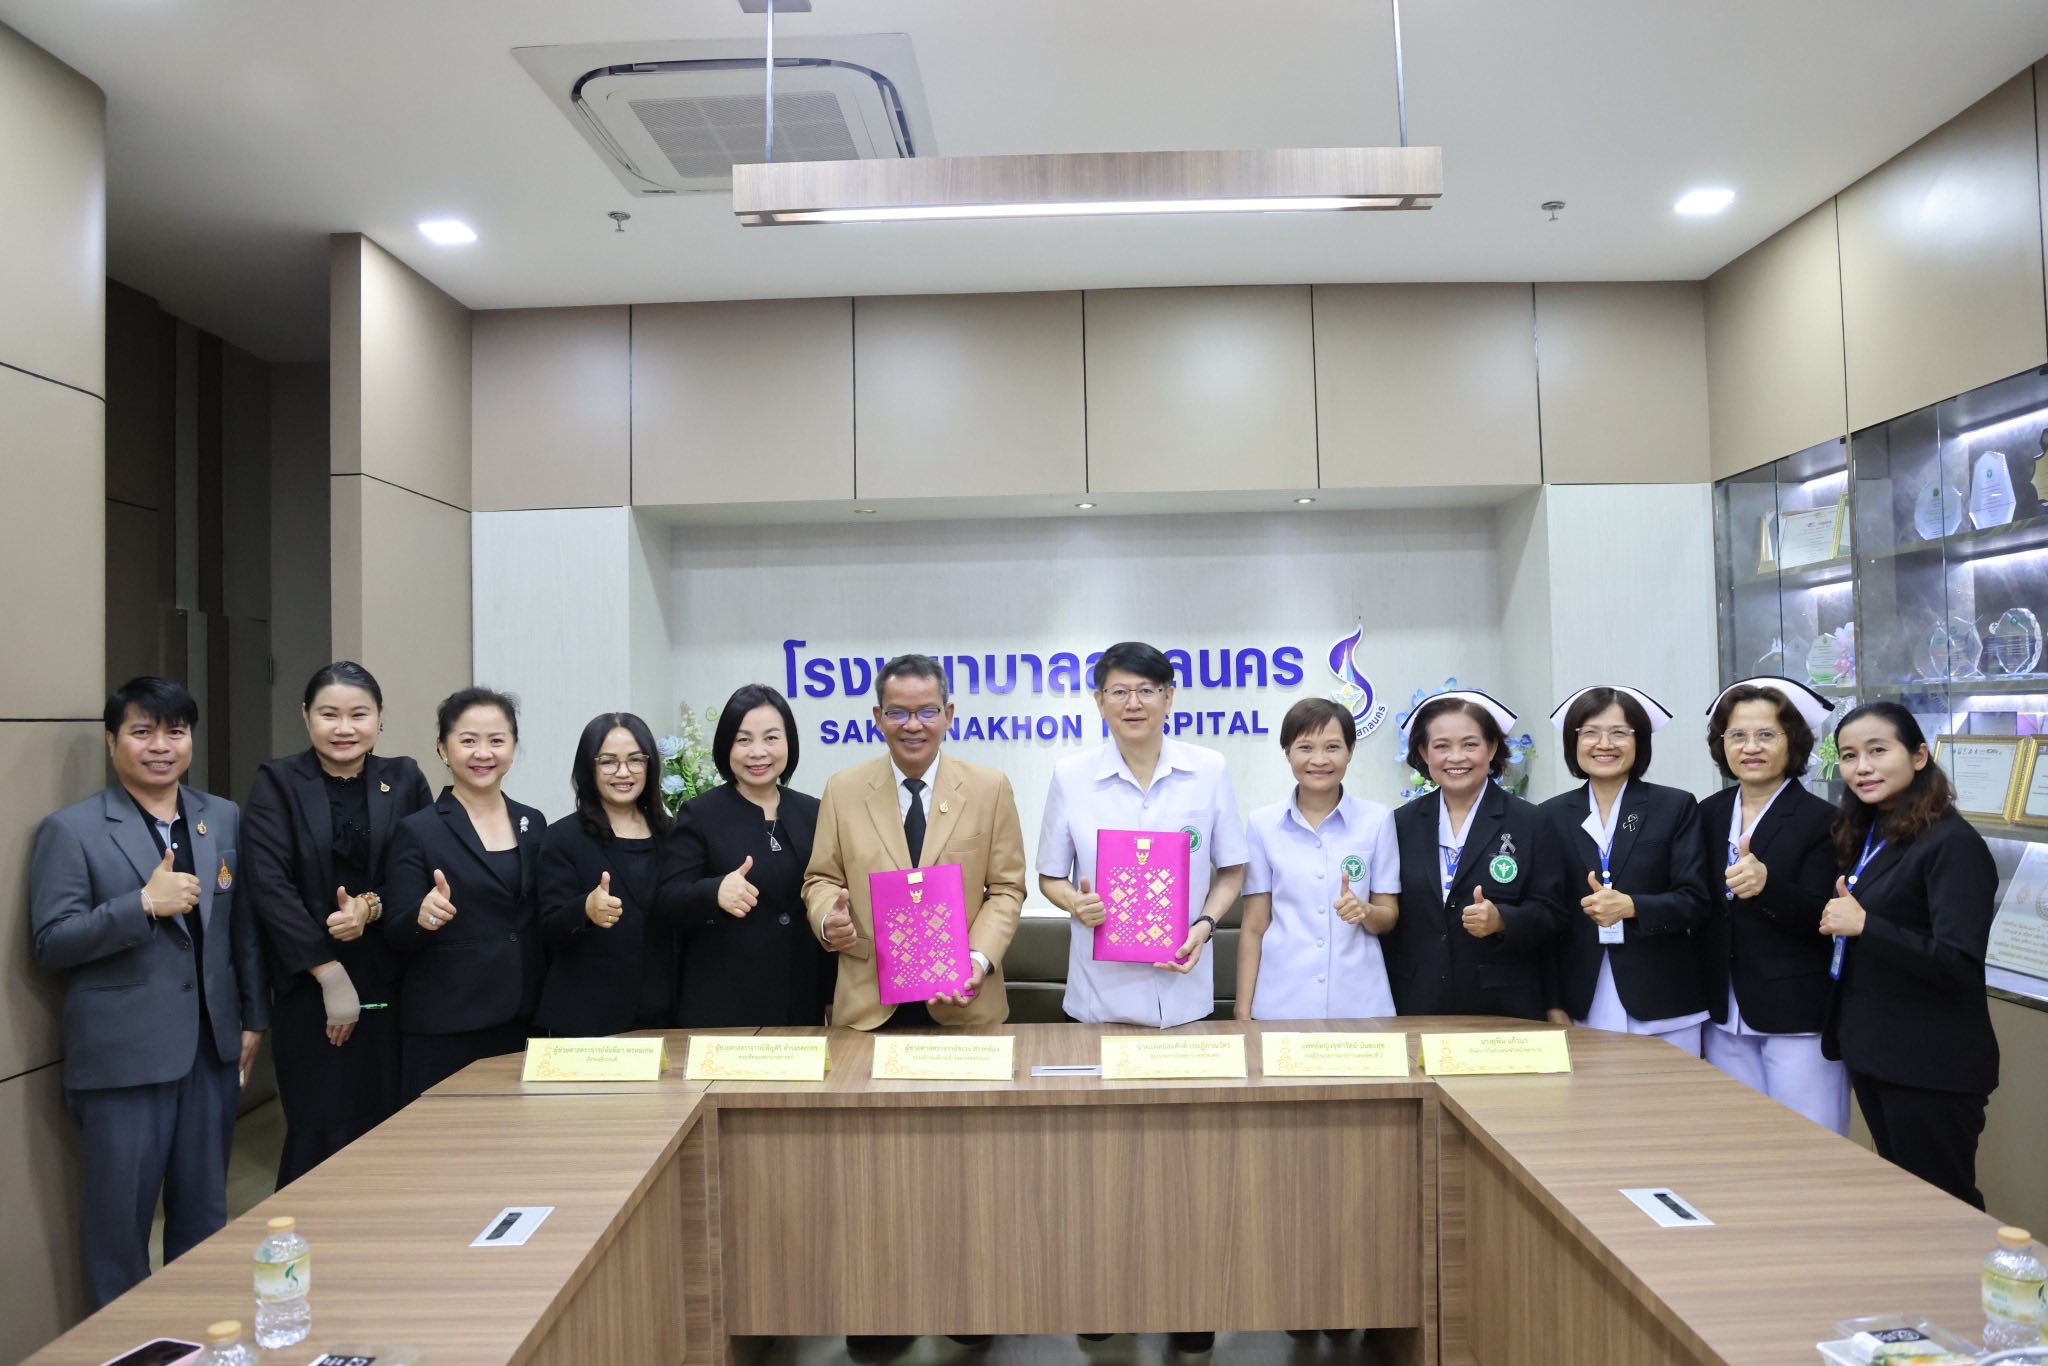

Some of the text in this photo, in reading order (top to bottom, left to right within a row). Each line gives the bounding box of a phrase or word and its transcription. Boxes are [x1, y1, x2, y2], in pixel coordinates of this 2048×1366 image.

[783, 639, 1304, 698] โรงาบาลลนคร
[1102, 710, 1269, 738] PITAL
